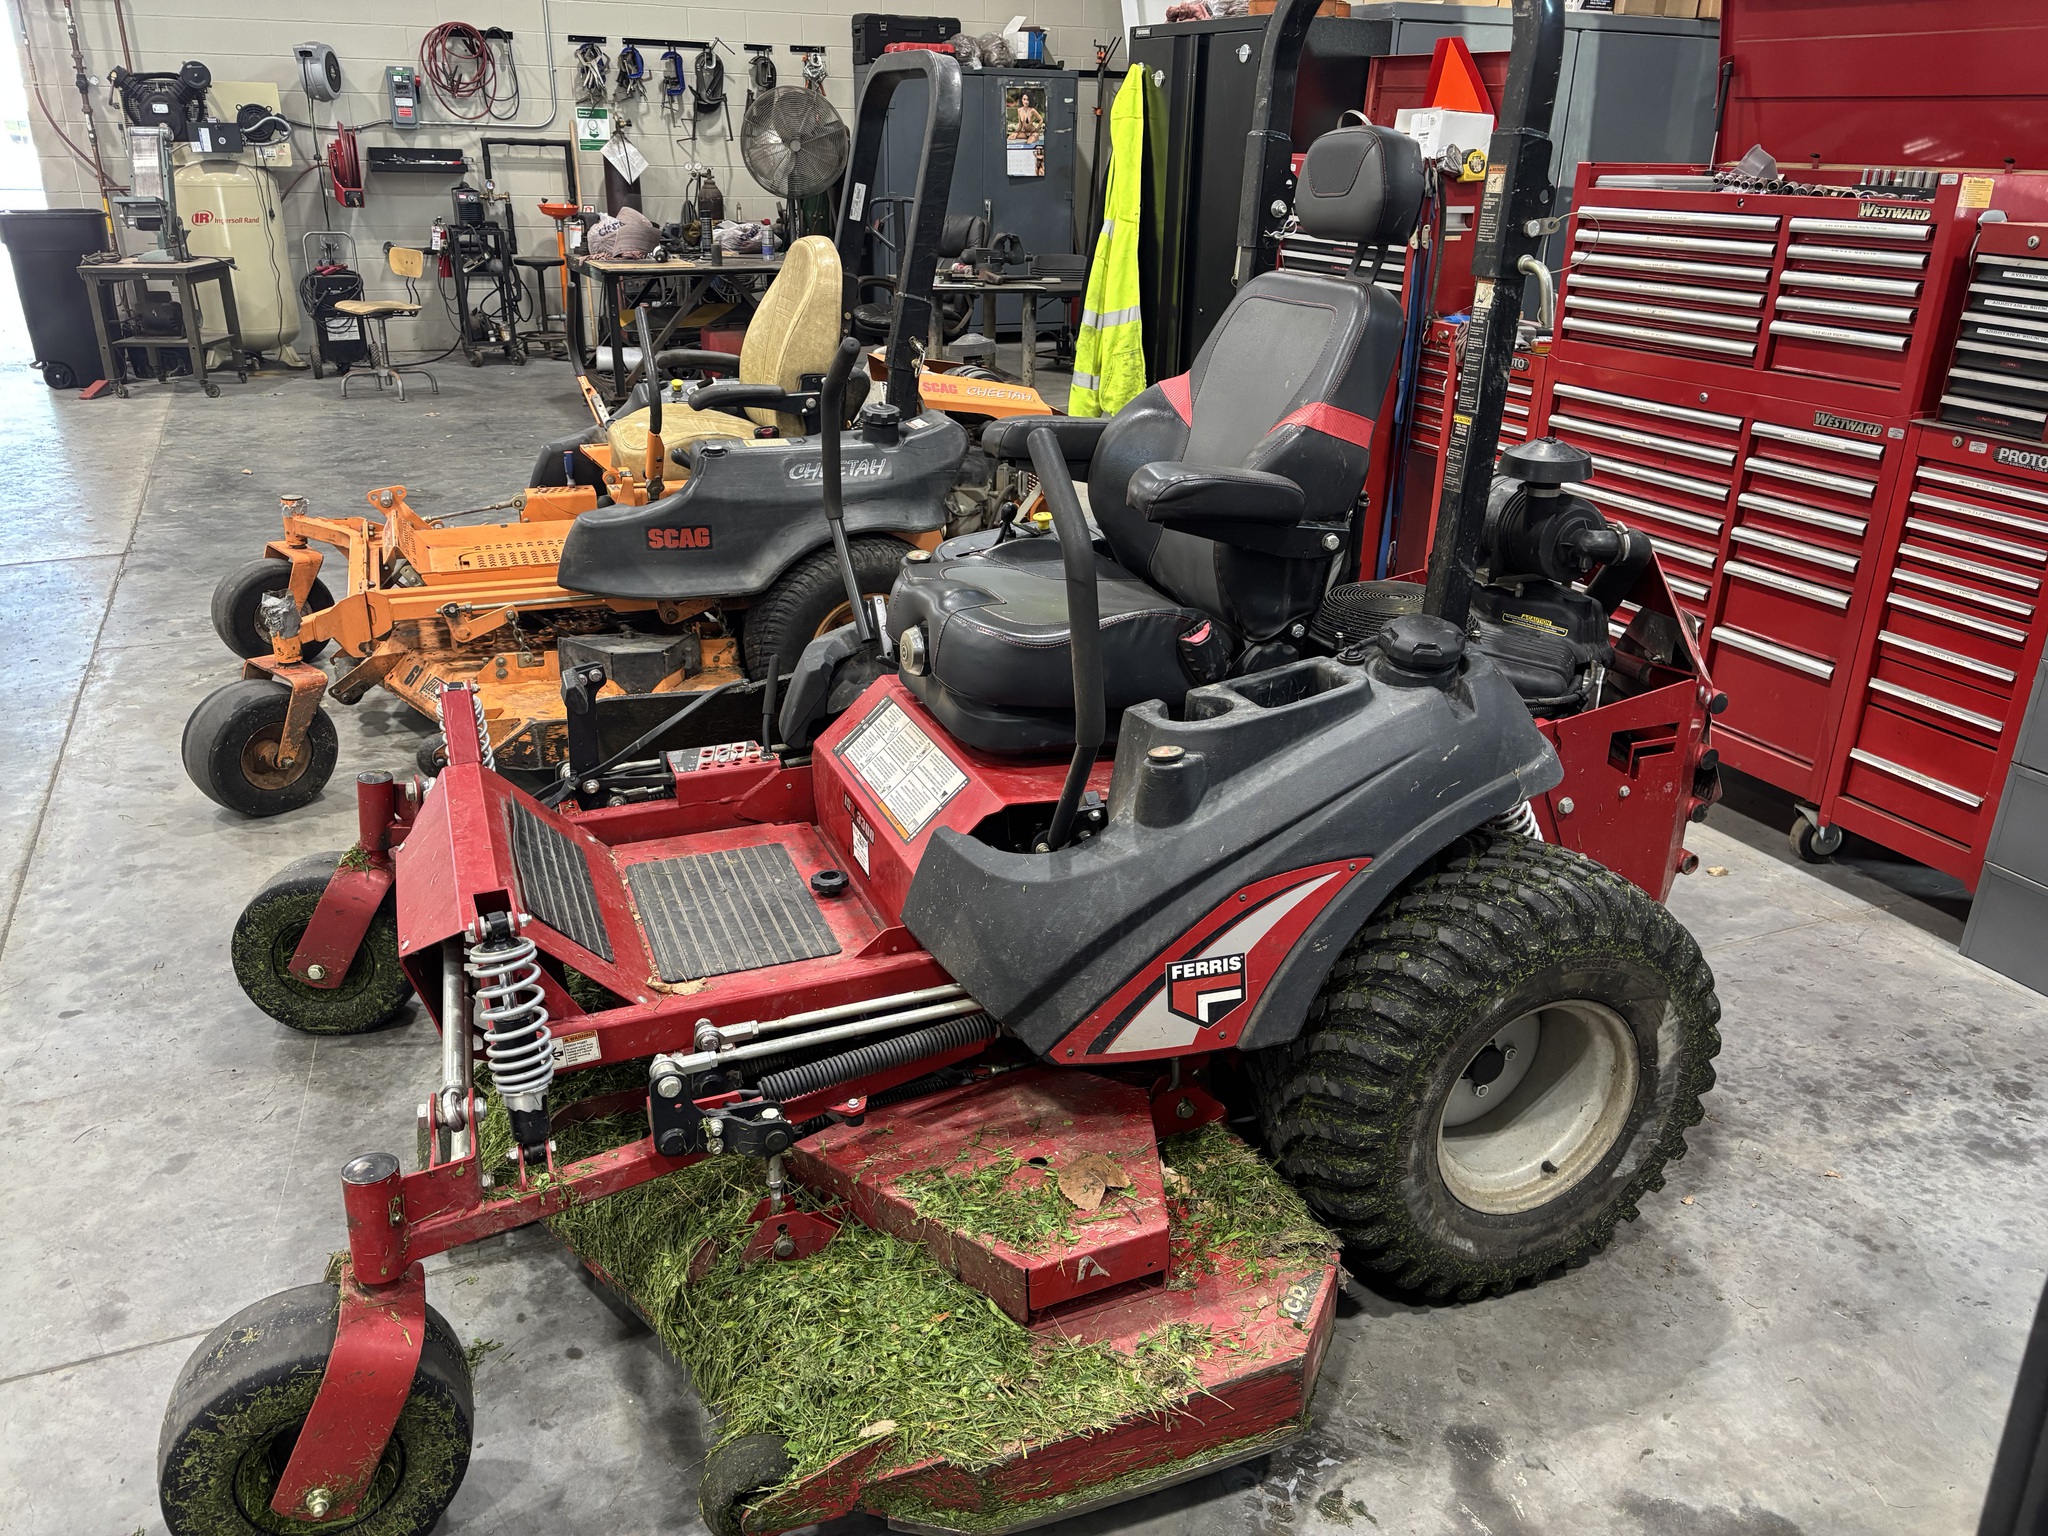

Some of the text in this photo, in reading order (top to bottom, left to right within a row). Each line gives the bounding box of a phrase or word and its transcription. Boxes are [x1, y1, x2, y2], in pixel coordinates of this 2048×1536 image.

[215, 217, 243, 225] Ingersoll
[1860, 202, 1931, 221] WESTWARD
[922, 382, 1032, 401] SCAG CHEETAH
[1815, 413, 1882, 435] WESTWARD
[1999, 448, 2048, 468] PROTO
[789, 459, 886, 479] CHETAH
[648, 528, 710, 548] SCAG
[1171, 956, 1242, 980] FERRIS
